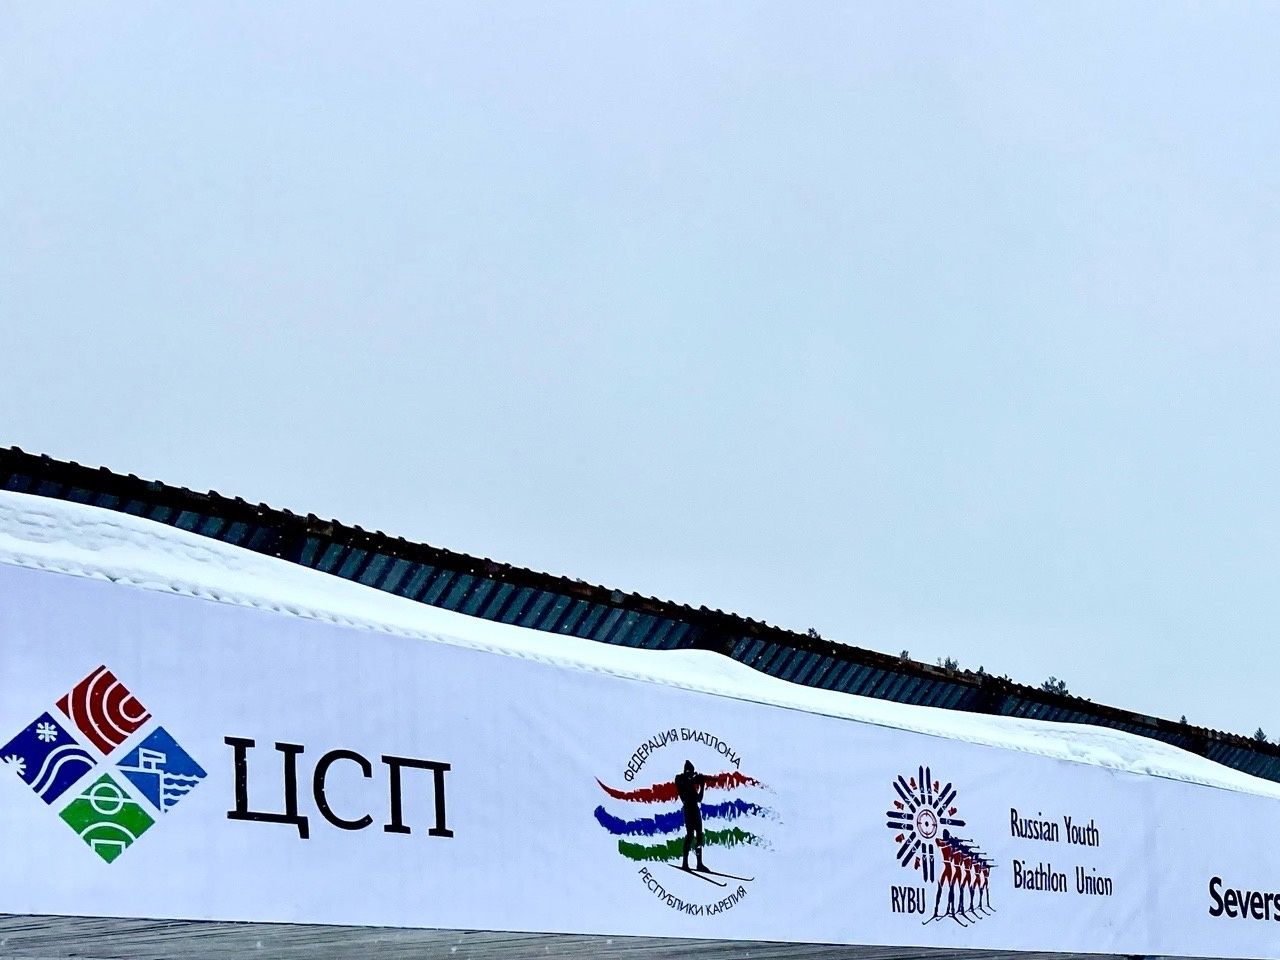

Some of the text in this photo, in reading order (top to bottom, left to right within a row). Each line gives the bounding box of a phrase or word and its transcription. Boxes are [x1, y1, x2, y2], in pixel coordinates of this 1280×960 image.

[624, 727, 741, 782] ФЕДЕРАЦИЯ БИАТЛОНА
[224, 736, 454, 839] ЦСП
[1010, 808, 1099, 847] Russian Youth
[638, 867, 748, 916] РЕСПУБЛИКИ КАРЕЛИЯ
[1013, 859, 1113, 896] Biathlon Union
[891, 886, 926, 915] RYBU
